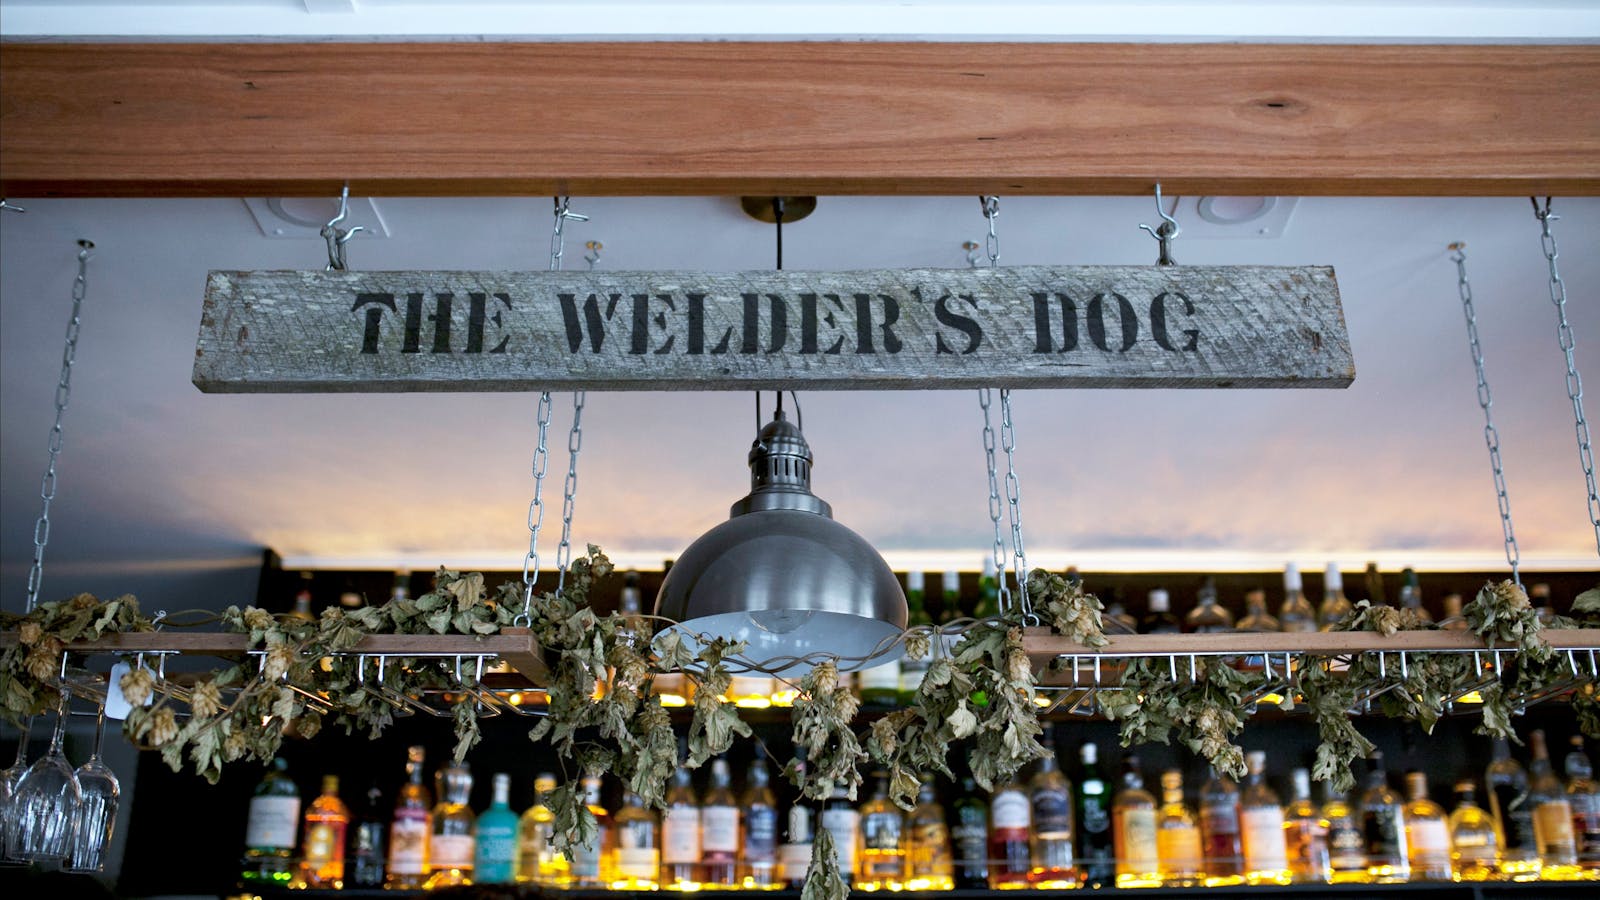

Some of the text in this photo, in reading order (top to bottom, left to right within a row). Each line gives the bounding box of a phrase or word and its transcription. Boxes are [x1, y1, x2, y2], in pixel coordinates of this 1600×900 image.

[352, 285, 1199, 355] THE WELDER'S DOG
